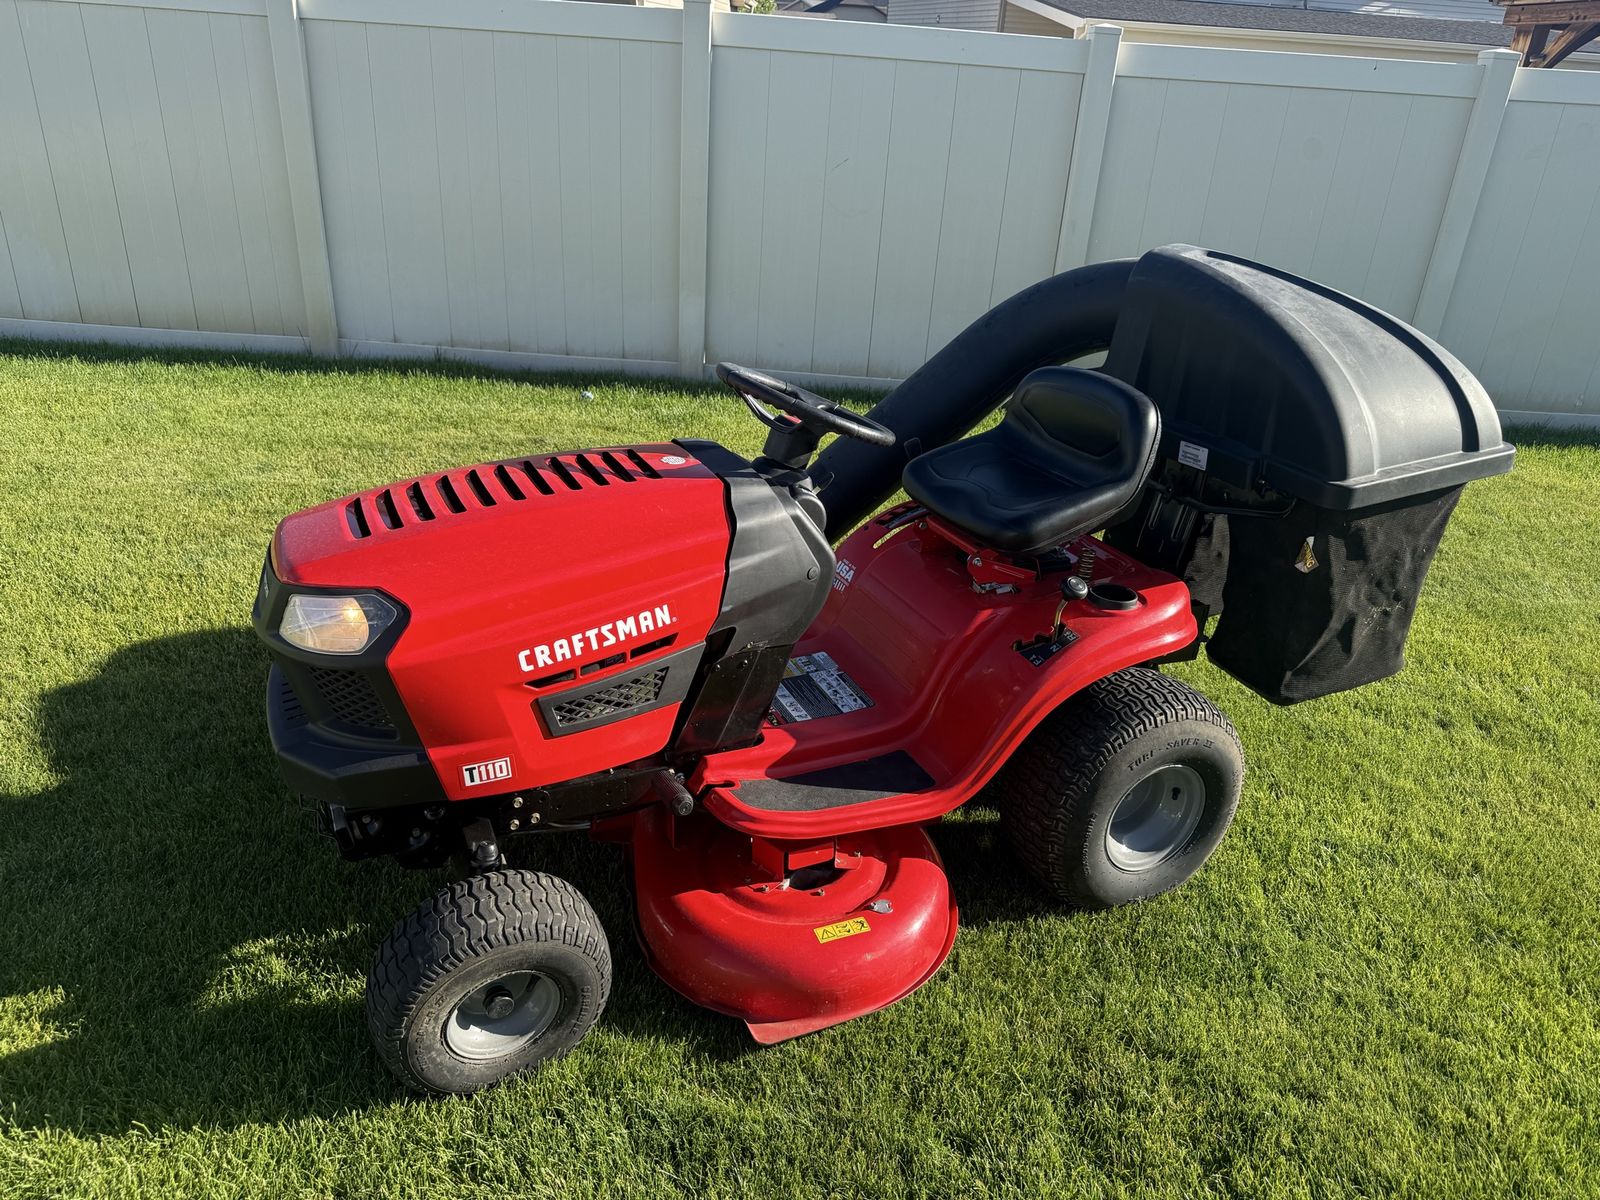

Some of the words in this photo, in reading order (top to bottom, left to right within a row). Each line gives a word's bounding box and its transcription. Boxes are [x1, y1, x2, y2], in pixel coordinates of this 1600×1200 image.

[836, 561, 854, 582] USA
[518, 604, 671, 672] CRAFTSMAN
[465, 761, 508, 783] T110
